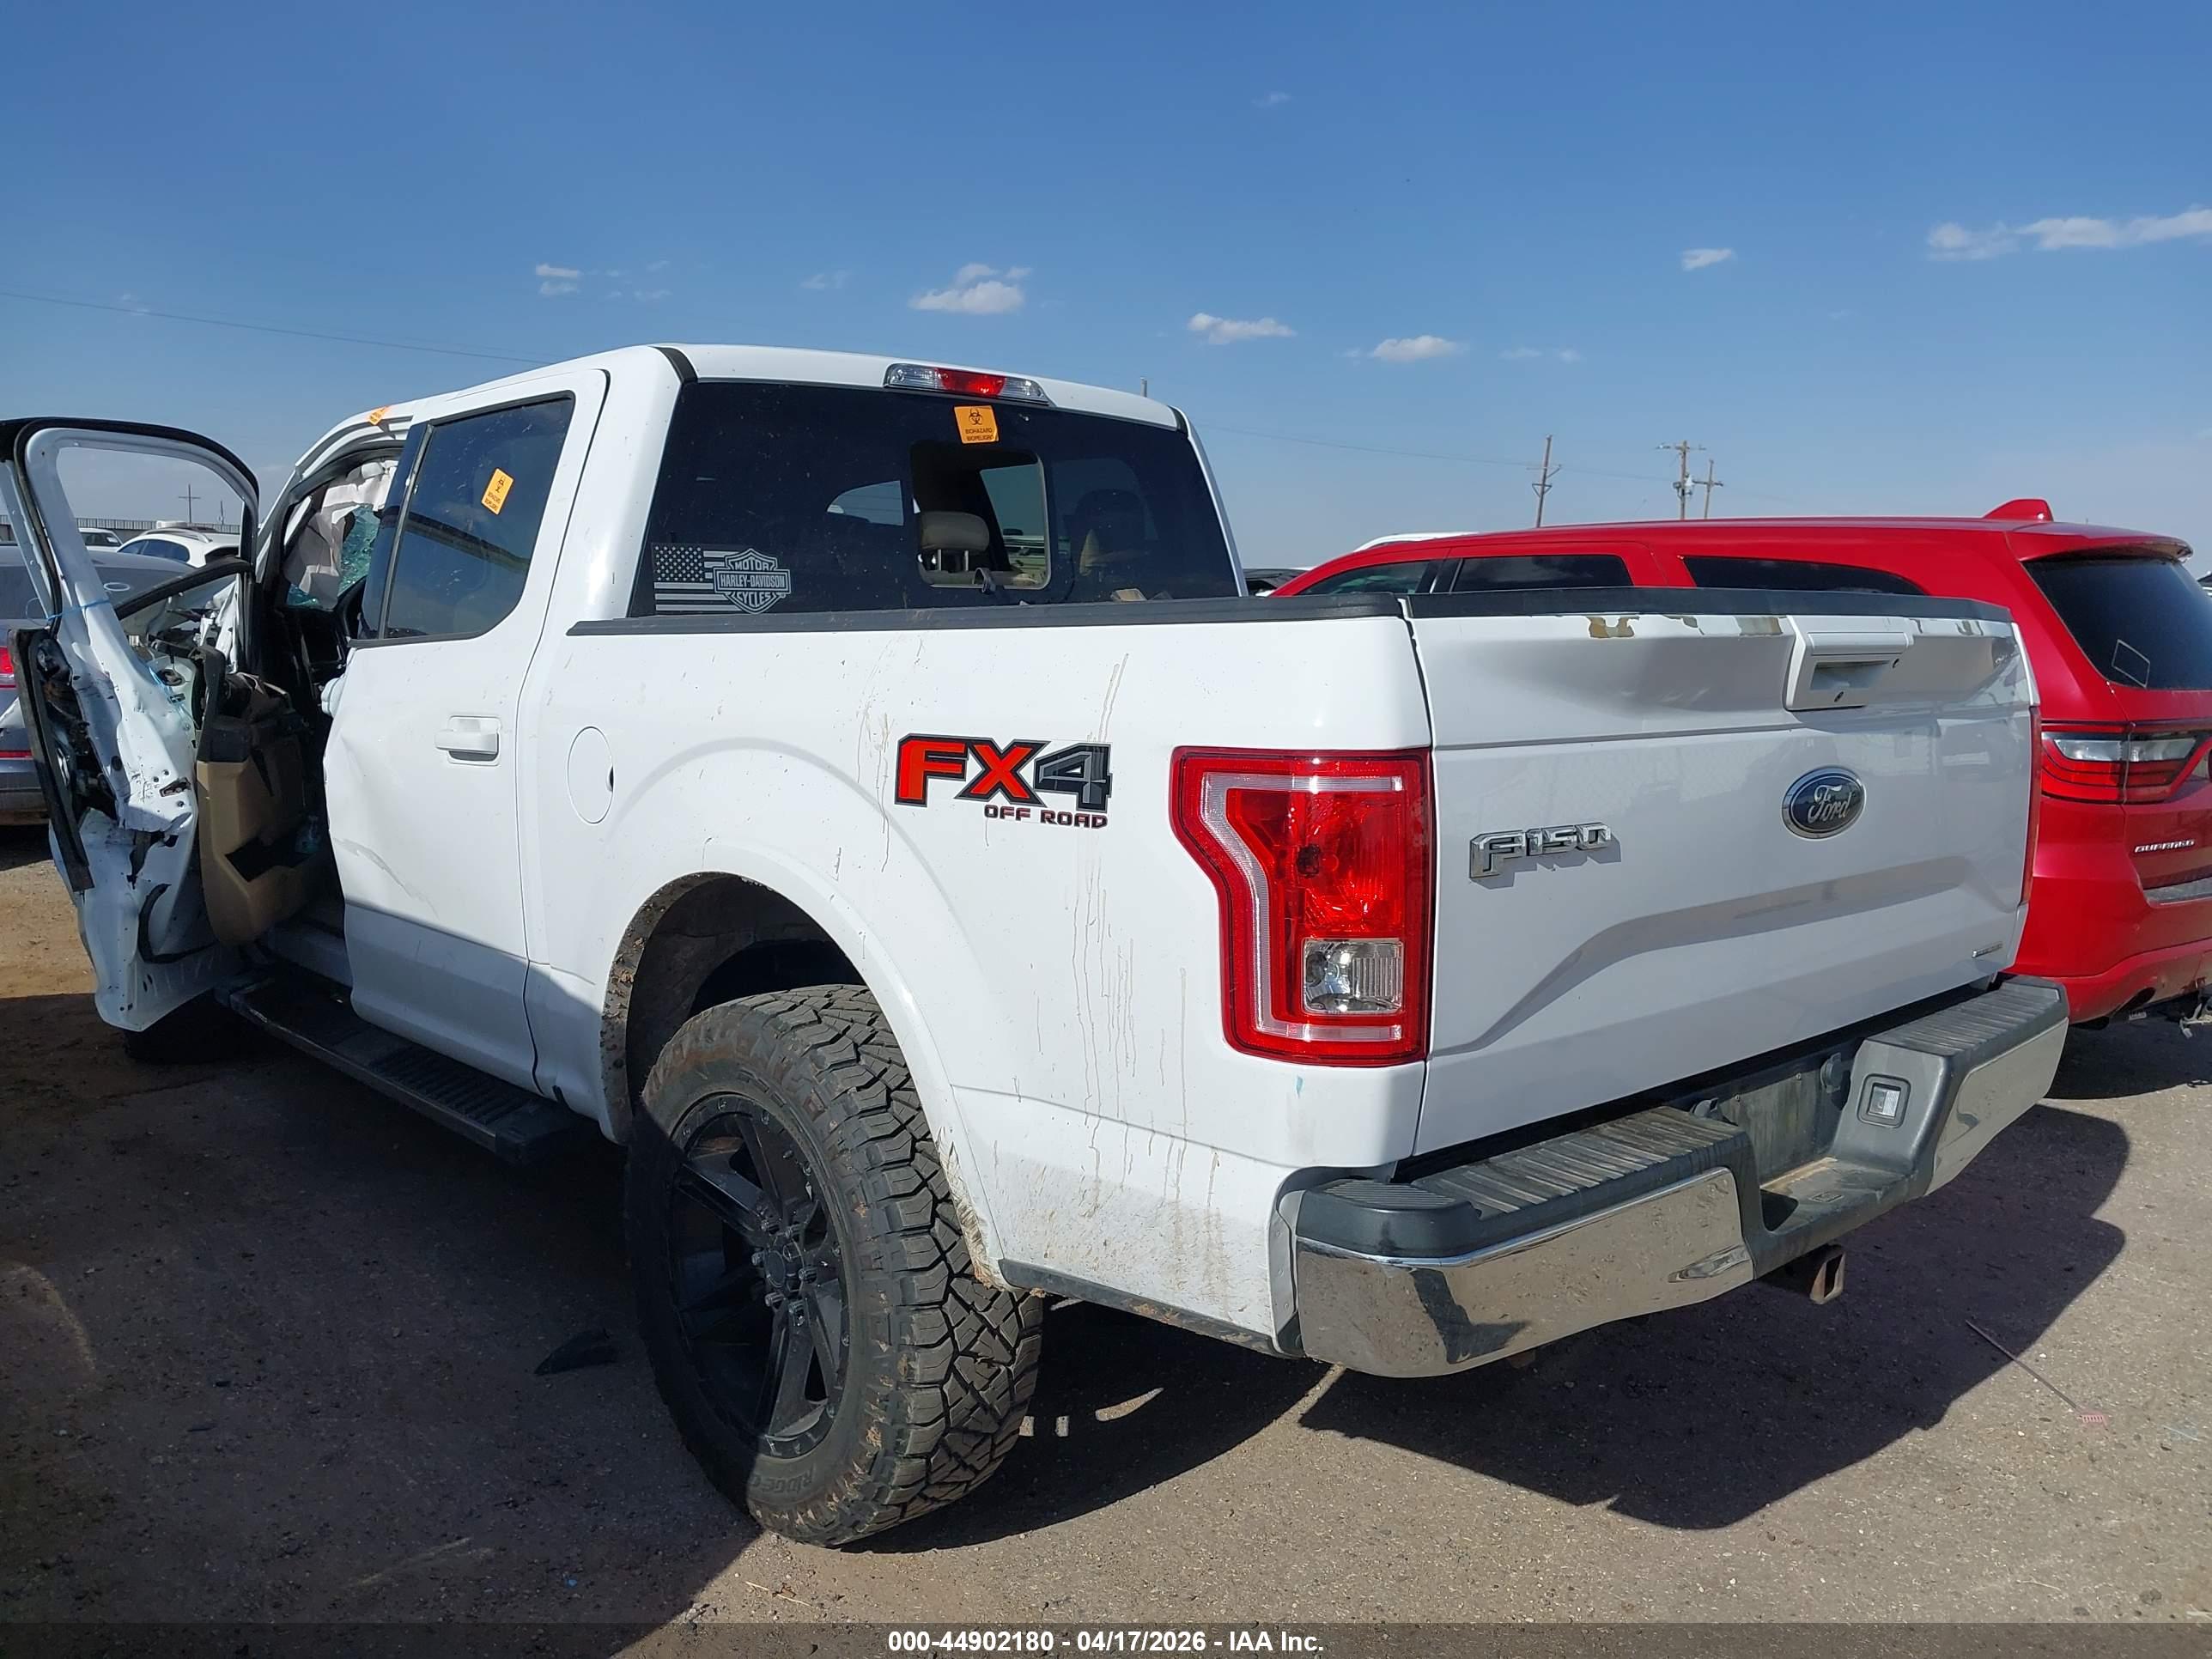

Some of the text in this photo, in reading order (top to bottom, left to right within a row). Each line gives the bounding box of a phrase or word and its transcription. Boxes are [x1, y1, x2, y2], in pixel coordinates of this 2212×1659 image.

[734, 559, 769, 571] MOTOR
[720, 574, 786, 588] HARLEY-DAVIDSON
[736, 592, 772, 607] CYCLES
[894, 733, 1114, 813] FX4
[1807, 785, 1852, 823] Ford
[984, 804, 1109, 830] OFF ROAD
